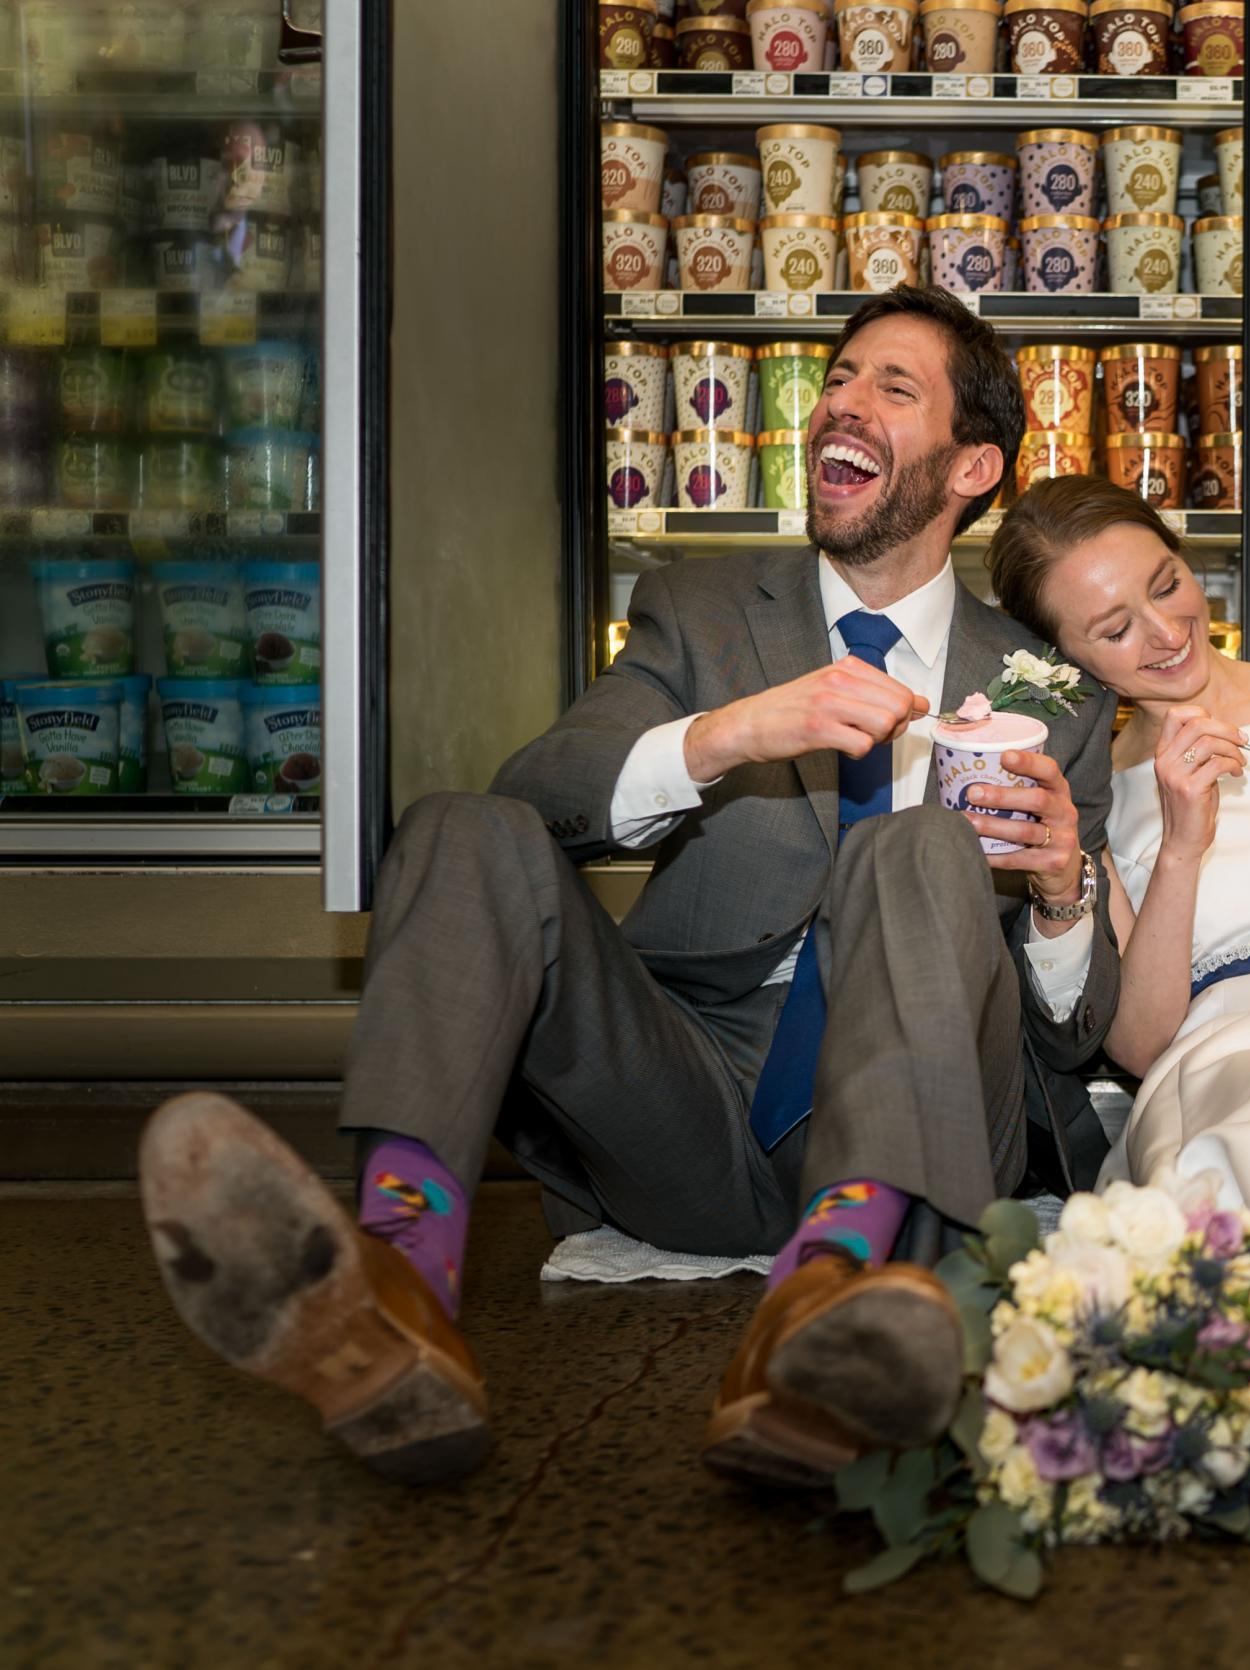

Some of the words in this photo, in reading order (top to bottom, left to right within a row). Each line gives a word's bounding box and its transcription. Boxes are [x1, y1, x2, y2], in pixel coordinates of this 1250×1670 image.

[758, 13, 790, 42] HALO
[798, 17, 817, 43] TOP
[845, 12, 875, 41] HALO
[883, 14, 902, 41] TOP
[953, 18, 975, 42] TOP
[1010, 13, 1036, 45] HALO
[1043, 15, 1066, 41] TOP
[1102, 13, 1135, 43] HALO
[1141, 16, 1161, 44] TOP
[616, 37, 640, 55] 280
[723, 39, 743, 63] TOP
[774, 40, 799, 57] 280
[933, 42, 957, 60] 280
[254, 146, 282, 167] BLVD
[625, 146, 647, 171] TOP
[787, 144, 811, 170] TOP
[1034, 147, 1066, 175] HALO
[1118, 146, 1151, 174] HALO
[169, 165, 197, 181] BLVD
[602, 168, 627, 186] 320
[722, 169, 745, 193] TOP
[769, 170, 793, 186] 240
[871, 168, 904, 195] HALO
[973, 169, 995, 192] TOP
[1050, 174, 1076, 191] 280
[1134, 173, 1161, 191] 240
[702, 193, 725, 209] 320
[887, 194, 913, 211] 240
[53, 232, 81, 249] BLVD
[641, 232, 659, 258] TOP
[682, 228, 712, 257] HALO
[720, 233, 741, 258] TOP
[772, 231, 806, 259] HALO
[813, 236, 832, 262] TOP
[856, 231, 890, 258] HALO
[1031, 231, 1061, 258] HALO
[1127, 231, 1161, 257] HALO
[1216, 238, 1242, 261] HAL
[615, 254, 643, 272] 320
[696, 255, 722, 273] 320
[789, 258, 815, 274] 240
[872, 259, 898, 275] 360
[966, 255, 992, 272] 280
[1045, 257, 1071, 274] 280
[1143, 258, 1169, 275] 240
[626, 363, 648, 387] TOP
[723, 363, 741, 388] TOP
[768, 361, 803, 389] HALO
[1149, 366, 1168, 391] TOP
[785, 388, 811, 402] 20
[1125, 391, 1152, 407] 320
[641, 454, 658, 478] TOP
[679, 447, 708, 474] HALO
[1215, 455, 1236, 477] TOP
[29, 711, 97, 730] Stonyfield
[39, 729, 62, 742] Gotta
[65, 728, 87, 743] Have
[46, 742, 79, 753] Vanilla
[944, 759, 986, 788] HALO
[960, 774, 977, 784] black
